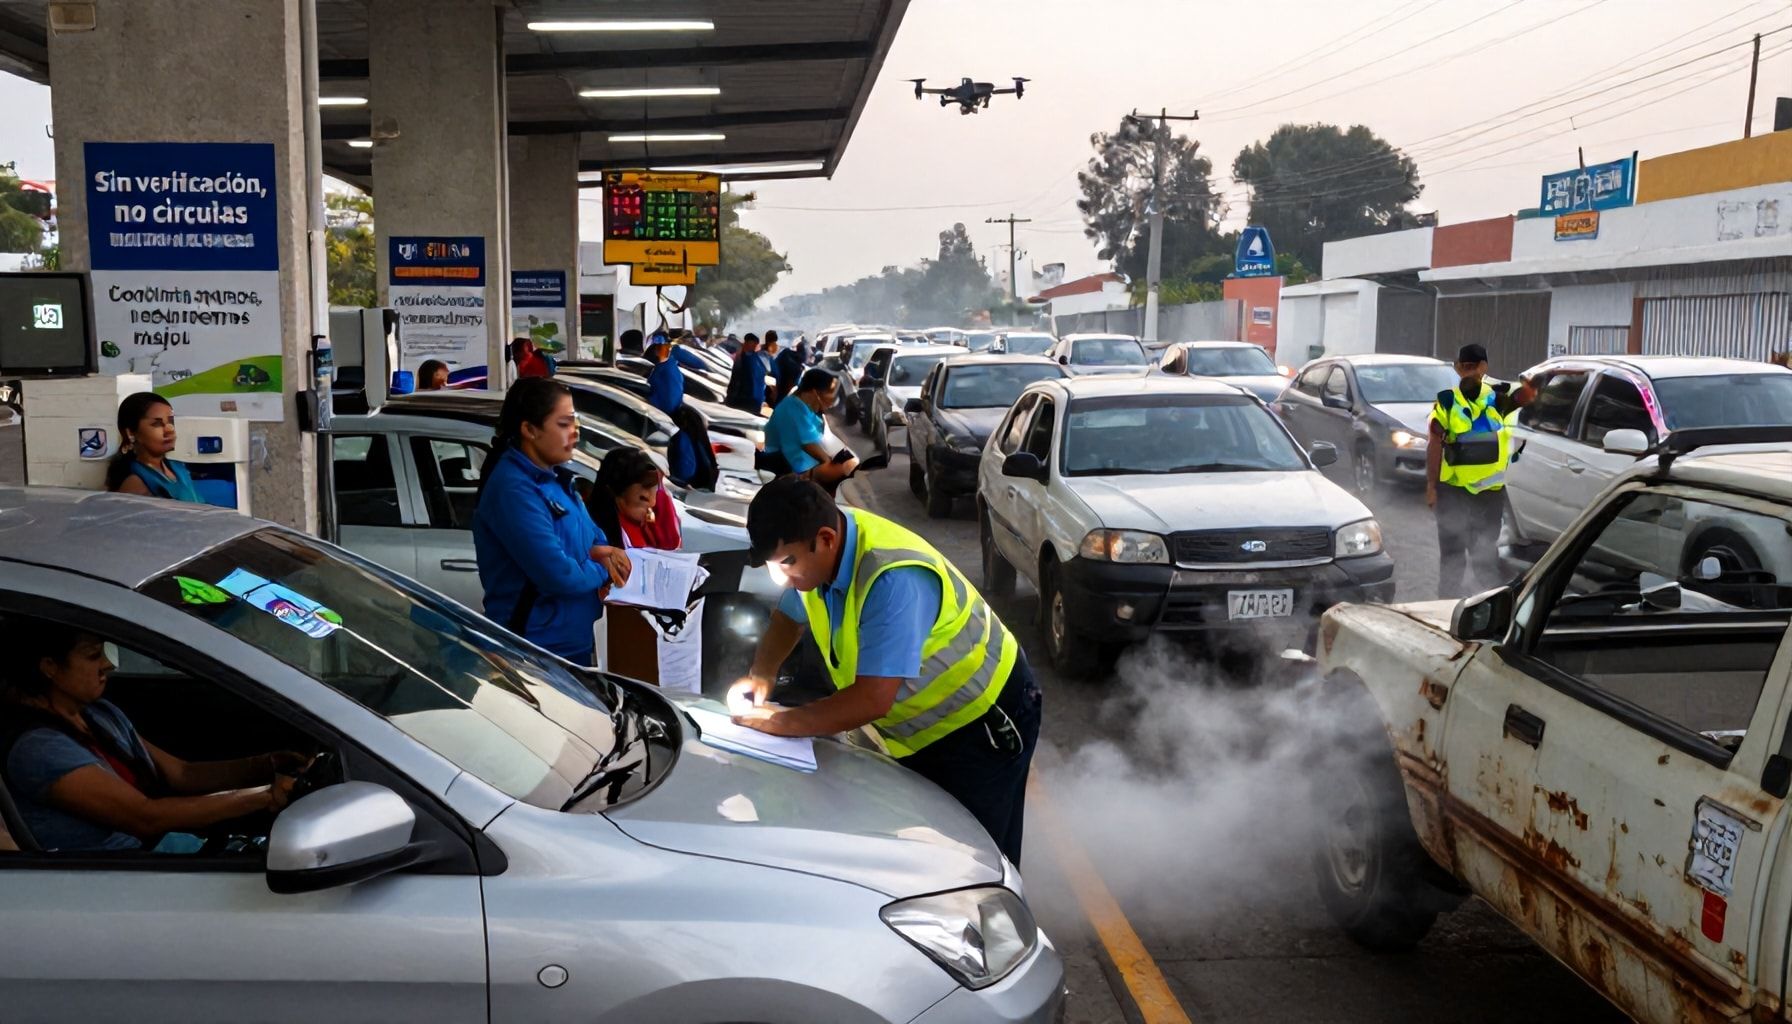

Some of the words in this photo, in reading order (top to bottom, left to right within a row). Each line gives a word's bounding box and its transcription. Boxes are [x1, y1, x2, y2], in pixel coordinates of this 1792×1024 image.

[95, 170, 131, 192] Sin
[115, 205, 146, 222] no
[153, 198, 247, 224] circulas
